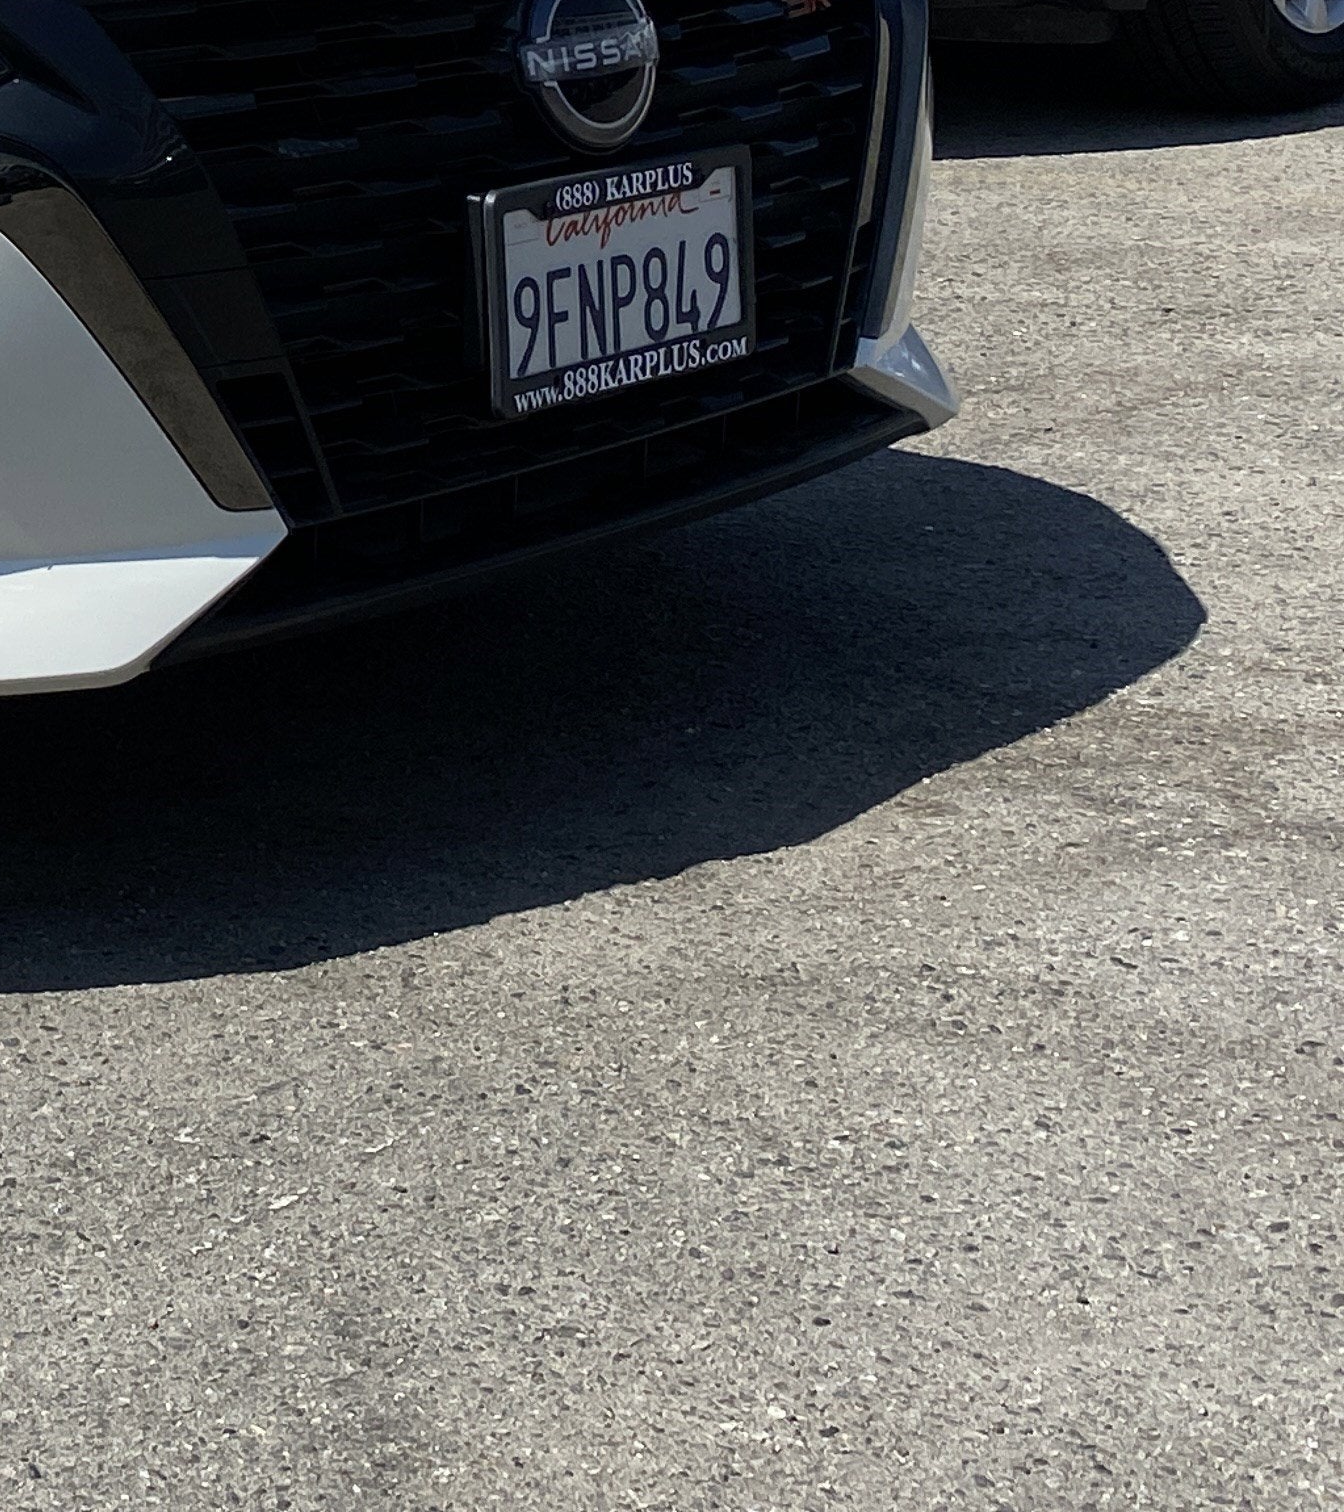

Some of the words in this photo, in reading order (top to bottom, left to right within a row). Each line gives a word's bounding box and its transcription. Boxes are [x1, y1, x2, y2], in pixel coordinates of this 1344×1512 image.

[526, 21, 655, 77] NISSA
[555, 180, 600, 211] (888)
[605, 163, 693, 201] KARPLUS
[514, 232, 730, 377] 9FNP849
